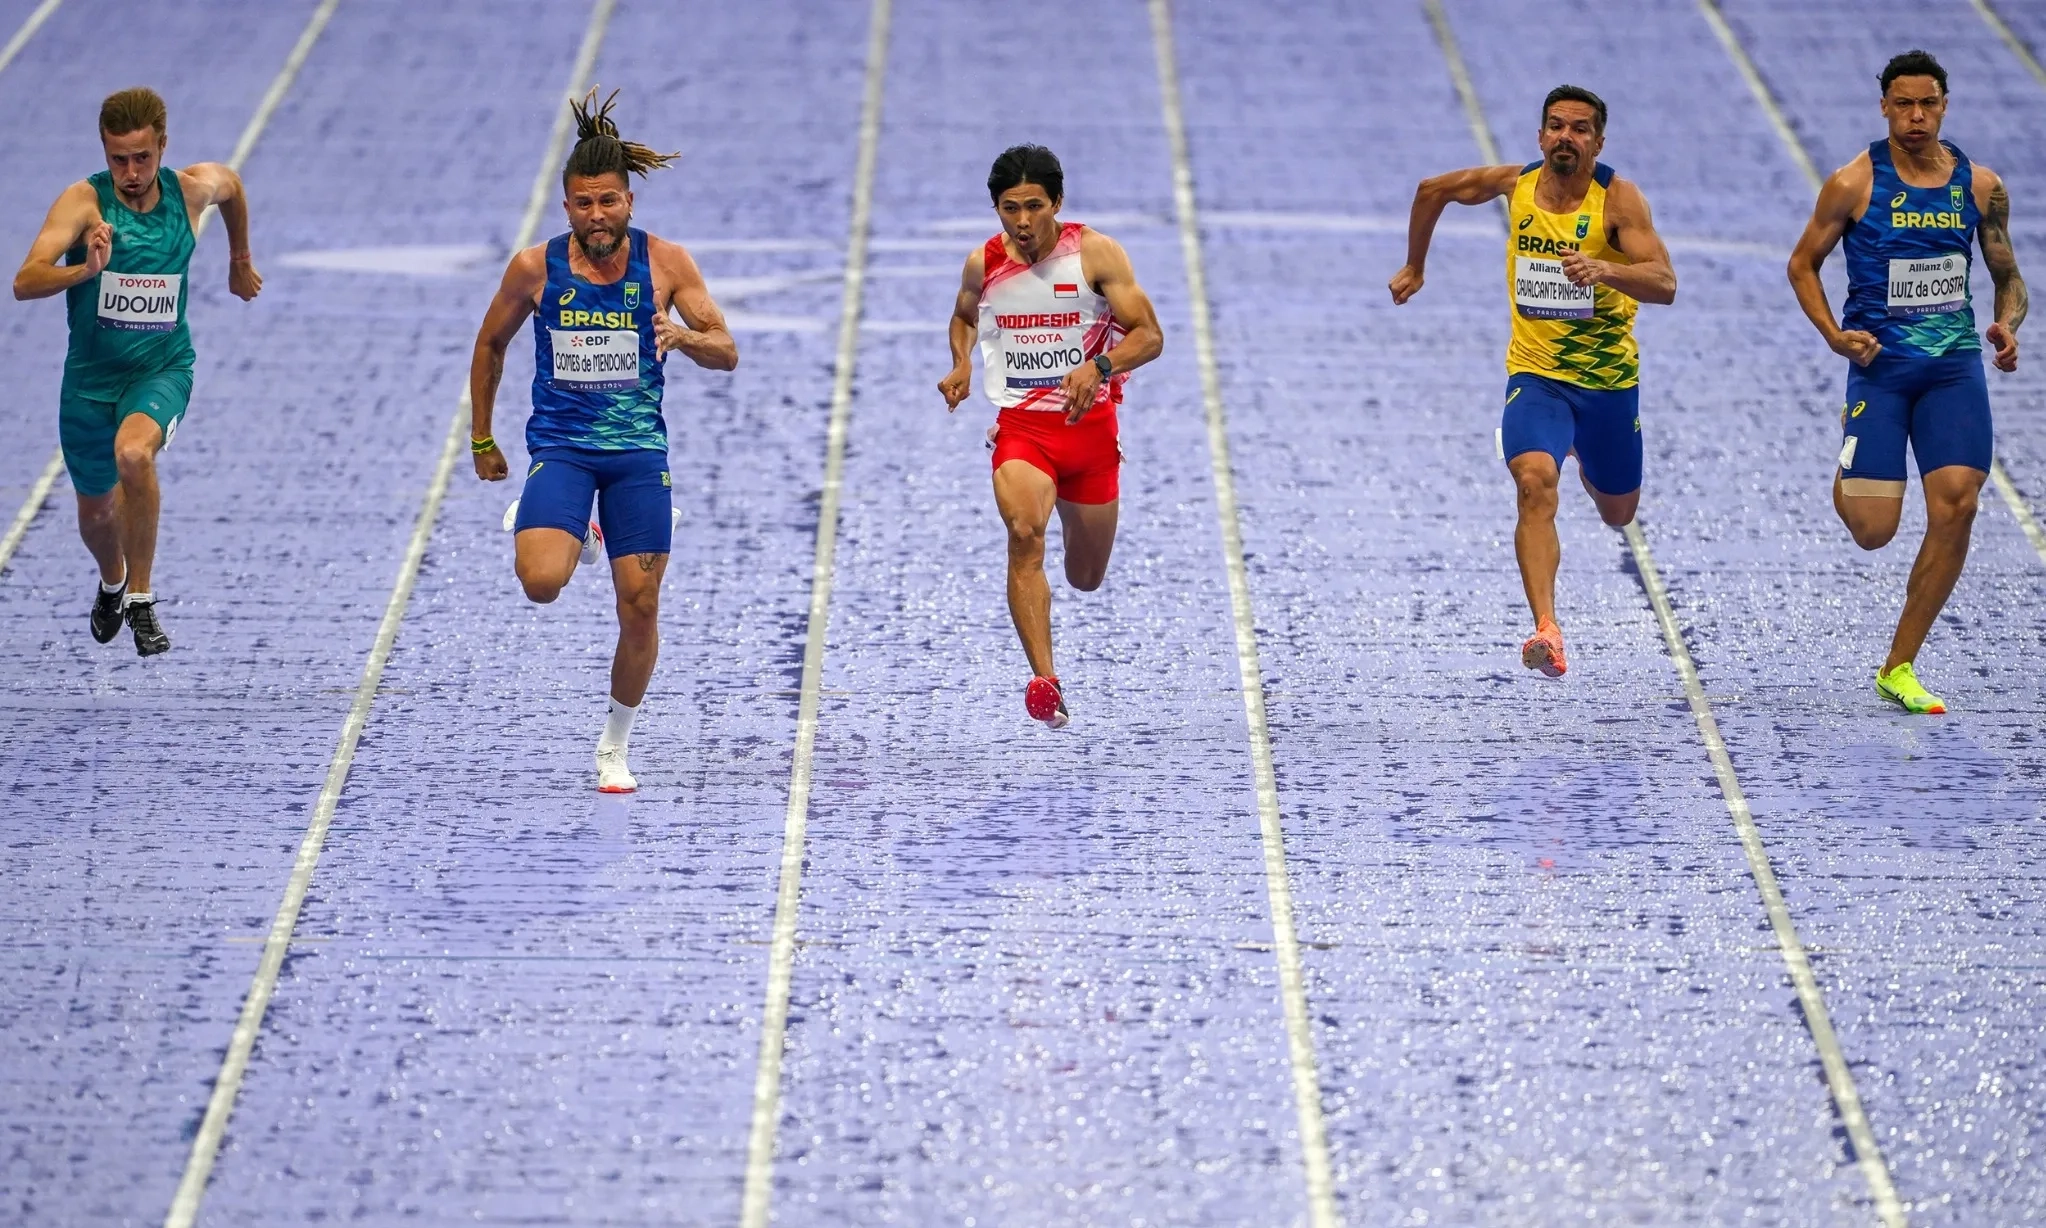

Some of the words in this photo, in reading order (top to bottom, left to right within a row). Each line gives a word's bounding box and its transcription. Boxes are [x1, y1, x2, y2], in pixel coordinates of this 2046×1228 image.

[1891, 212, 1966, 229] BRASIL
[1529, 262, 1561, 274] Allianz
[1908, 263, 1941, 273] Allianz
[118, 278, 167, 288] TOYOTA
[1891, 281, 1913, 298] LUIZ
[1915, 281, 1928, 298] da
[1931, 275, 1964, 296] COSTA
[560, 310, 638, 329] BRASIL
[994, 311, 1080, 329] INDONESIA
[1014, 333, 1063, 344] TOYOTA
[581, 354, 592, 372] de
[1005, 347, 1082, 370] PURNOMO
